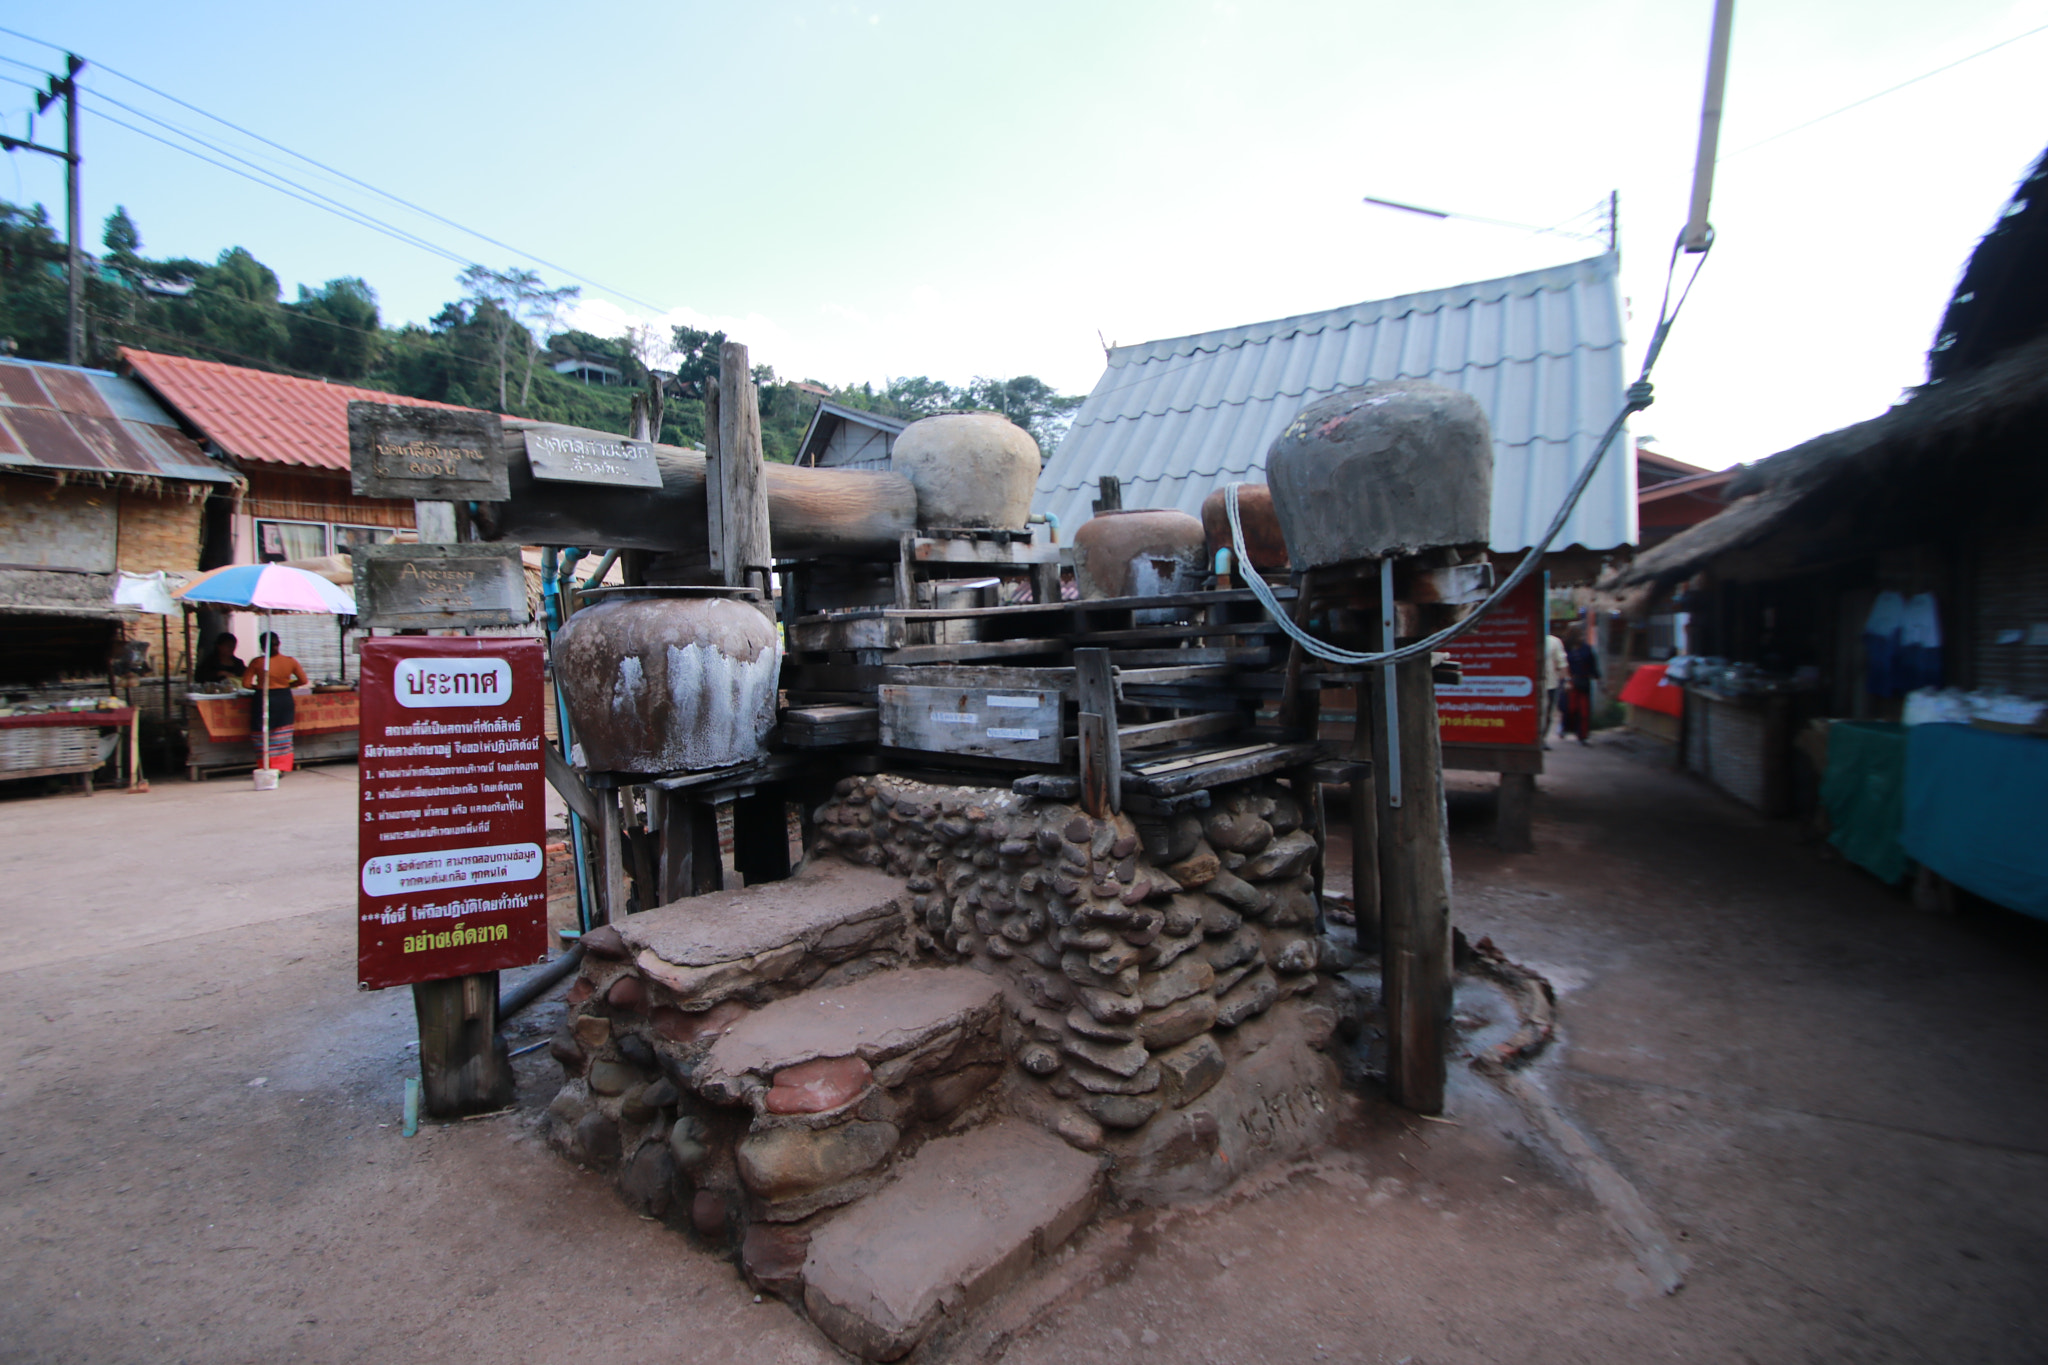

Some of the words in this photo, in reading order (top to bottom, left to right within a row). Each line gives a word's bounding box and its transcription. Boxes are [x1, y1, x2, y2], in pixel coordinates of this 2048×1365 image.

[376, 437, 484, 462] บ่อเกลือโบราณ
[536, 435, 649, 460] บุคคลภายนอก
[400, 562, 476, 581] ANCIENT
[427, 582, 465, 594] SALT
[418, 595, 473, 607] WELLS
[407, 669, 498, 695] ประกาศ
[365, 770, 375, 780] 1.
[497, 760, 539, 773] โดยเด็ดขาด
[364, 791, 375, 801] 2.
[481, 780, 523, 793] โดยเด็ดขาด
[364, 812, 375, 822] 3.
[452, 803, 468, 815] หรือ
[368, 860, 381, 875] ทั้ง
[385, 864, 392, 874] 3
[396, 858, 443, 873] ข้อดังกล่าว
[446, 849, 536, 867] สามารถสอบถามข้อมูล
[399, 869, 467, 887] จากคนต้มเกลือ
[471, 865, 508, 883] ทุกคนได้
[403, 922, 508, 954] อย่างเด็ดขาด
